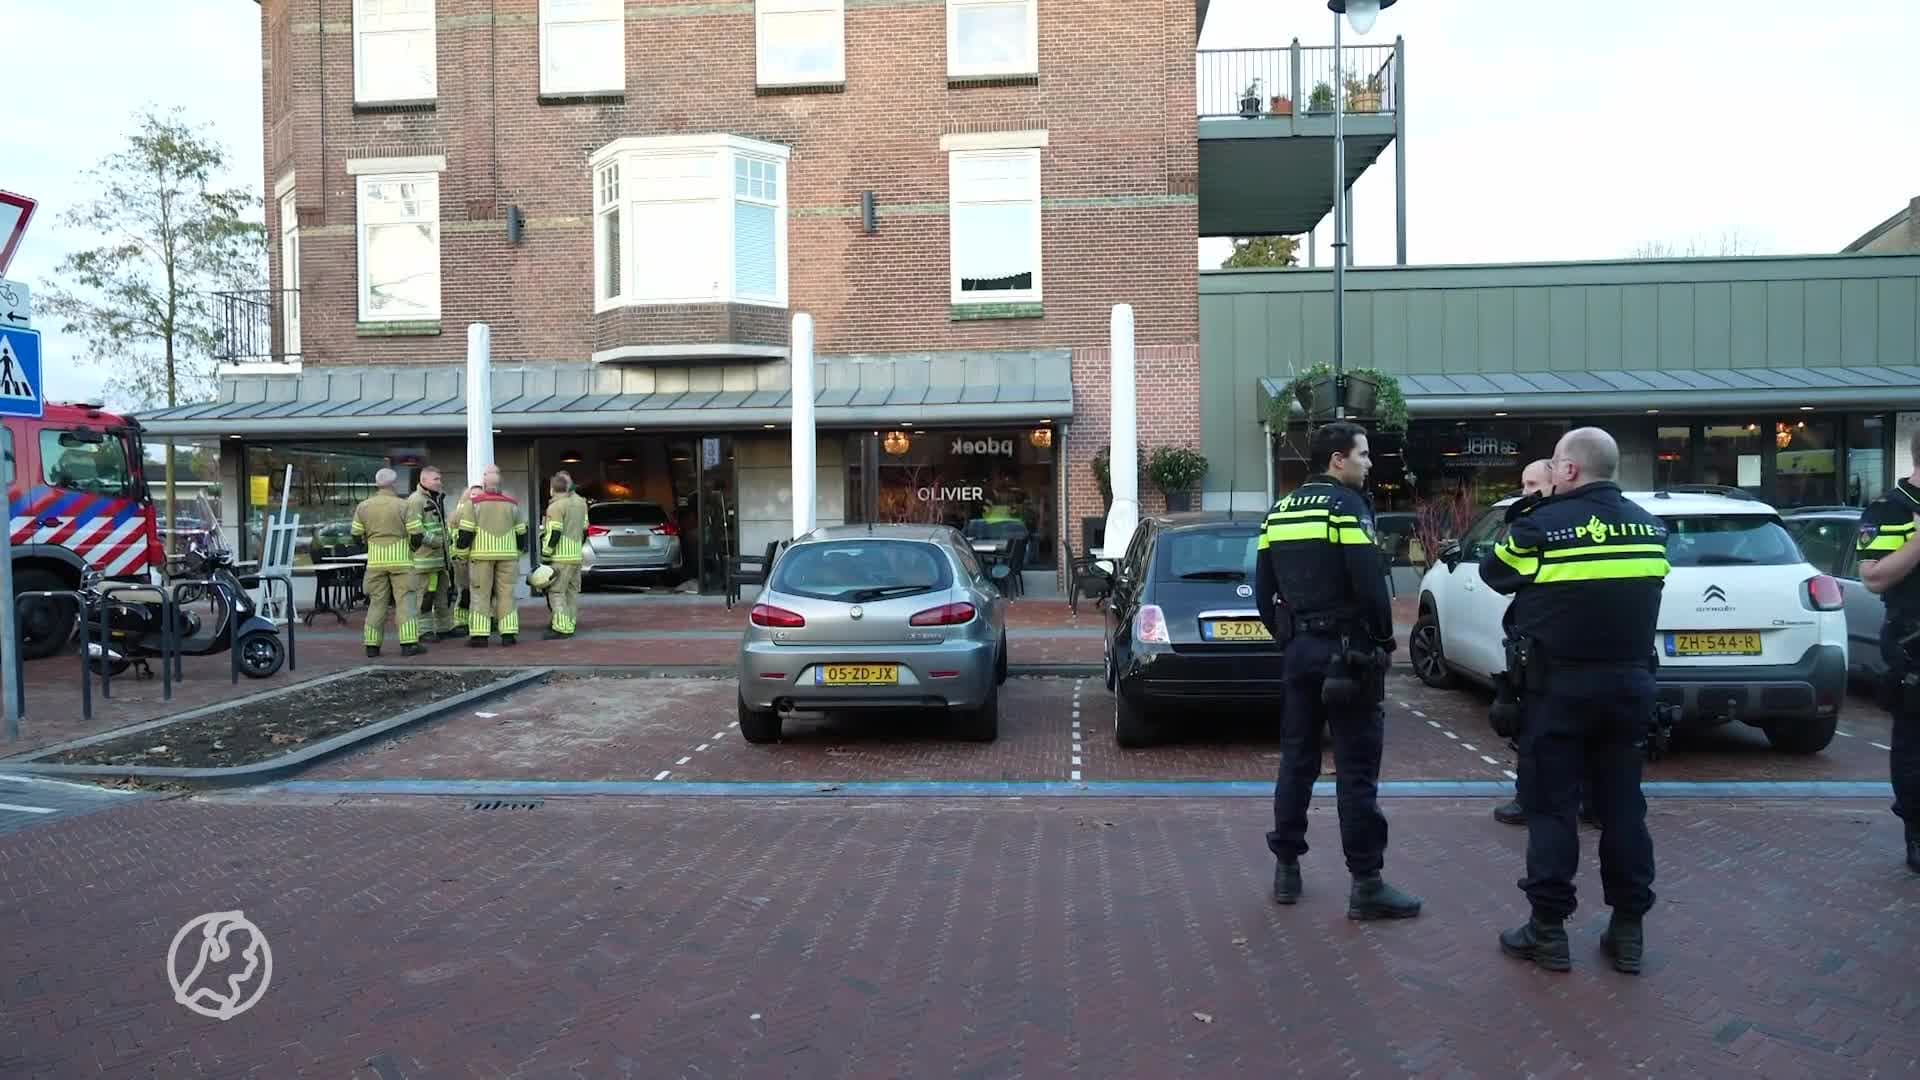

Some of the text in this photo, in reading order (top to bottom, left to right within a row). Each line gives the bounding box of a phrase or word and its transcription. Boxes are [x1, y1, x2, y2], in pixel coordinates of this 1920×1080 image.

[917, 486, 983, 502] OLIVIER
[1575, 515, 1655, 543] POLITIE
[1679, 636, 1754, 650] ZH-544-R
[828, 667, 892, 680] 05-ZD-JX
